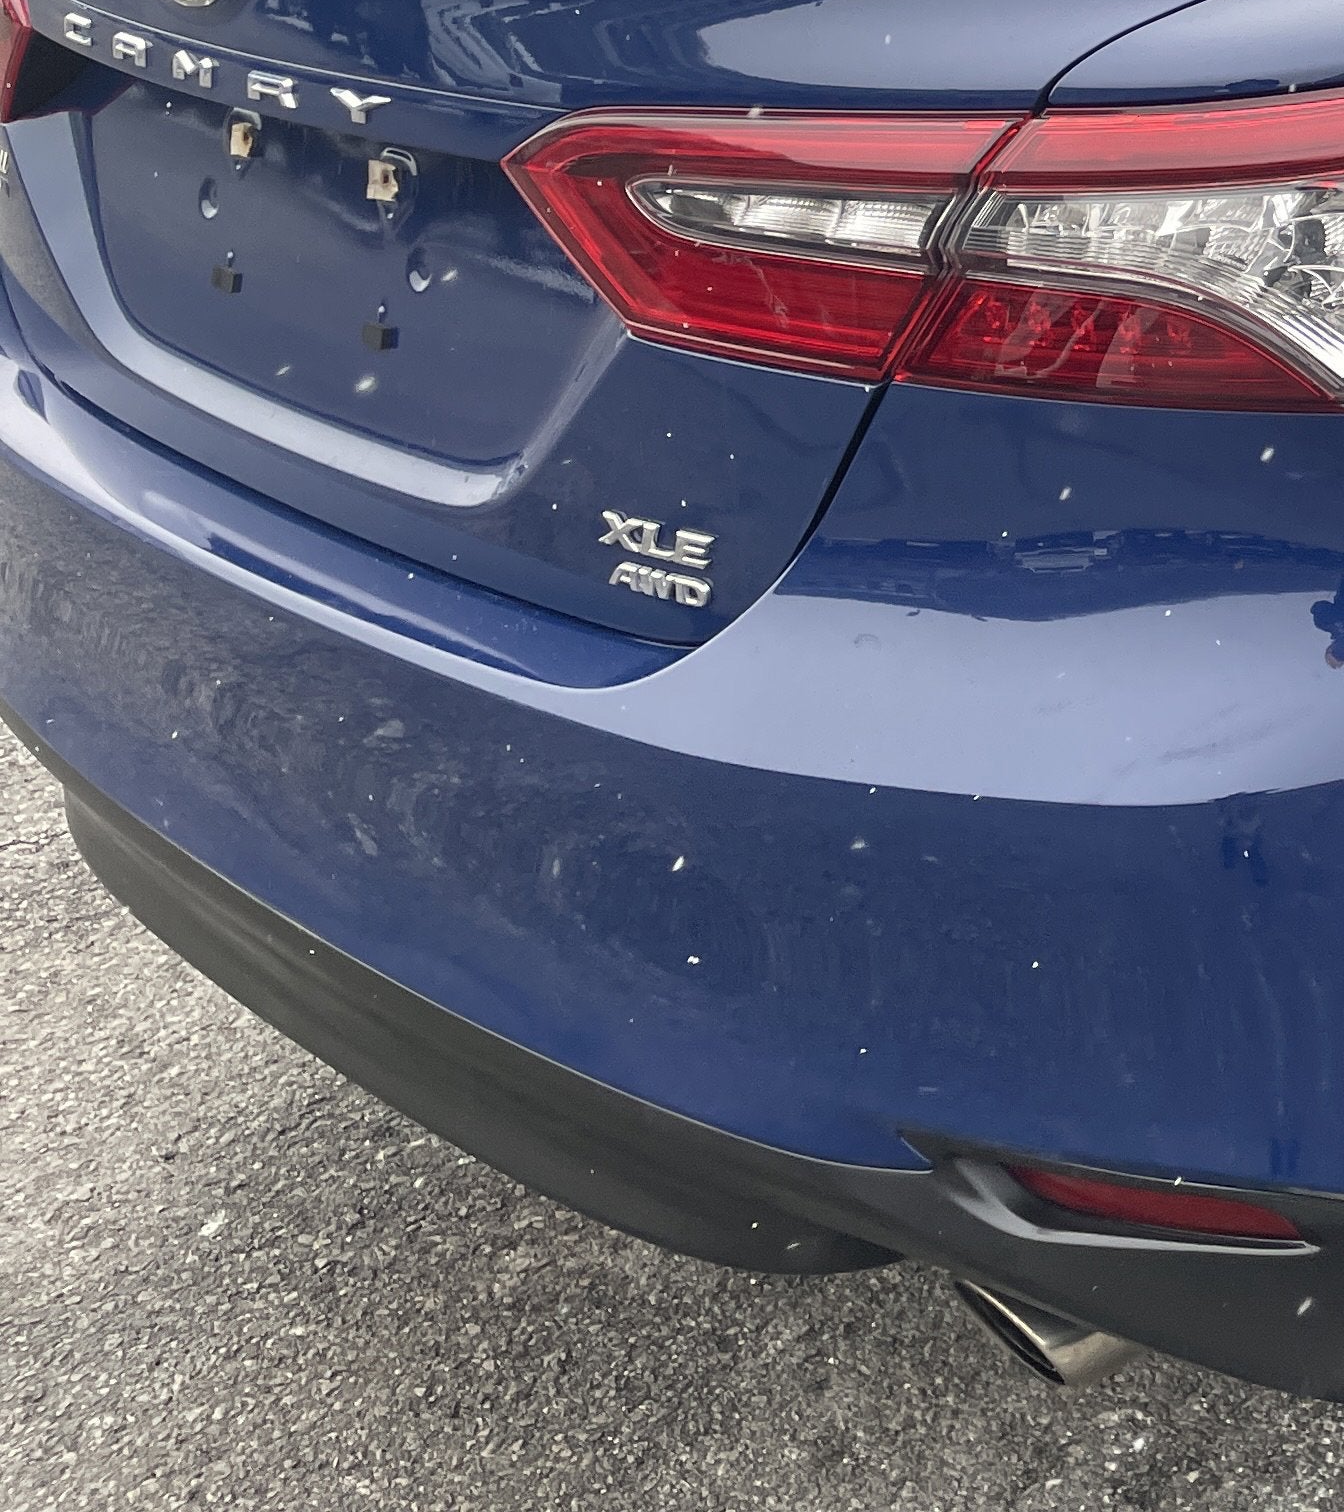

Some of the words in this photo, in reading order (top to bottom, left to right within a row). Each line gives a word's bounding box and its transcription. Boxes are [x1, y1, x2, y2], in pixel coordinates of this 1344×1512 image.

[63, 12, 392, 125] CAMRY
[599, 510, 718, 570] XLE
[609, 561, 713, 608] AWD
